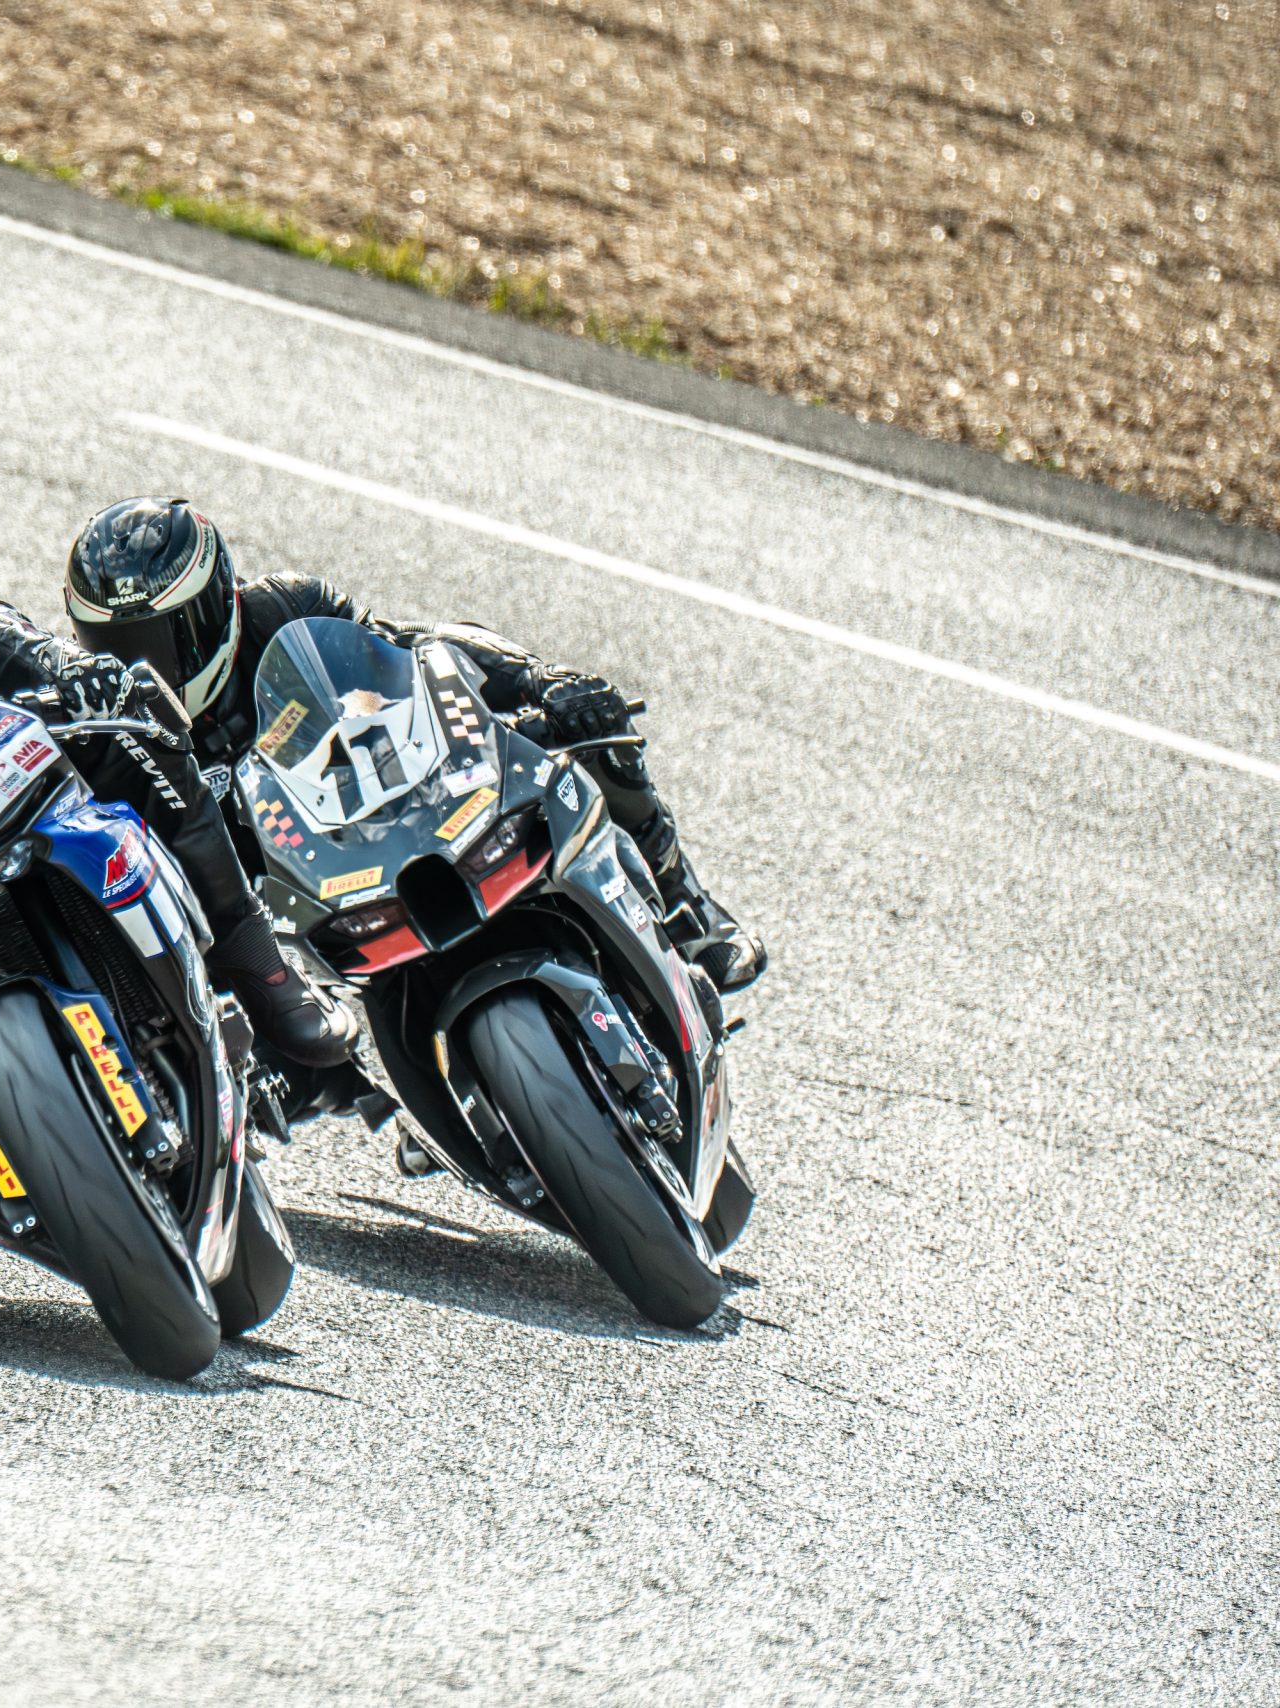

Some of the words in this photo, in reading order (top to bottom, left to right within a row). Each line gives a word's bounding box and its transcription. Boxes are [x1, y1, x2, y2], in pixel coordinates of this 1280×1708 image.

[107, 590, 150, 606] SHARK
[115, 732, 187, 810] REV'IT!
[443, 793, 490, 834] PIRELLI
[326, 869, 375, 894] PIRELLI
[74, 1010, 137, 1126] PIRELLI
